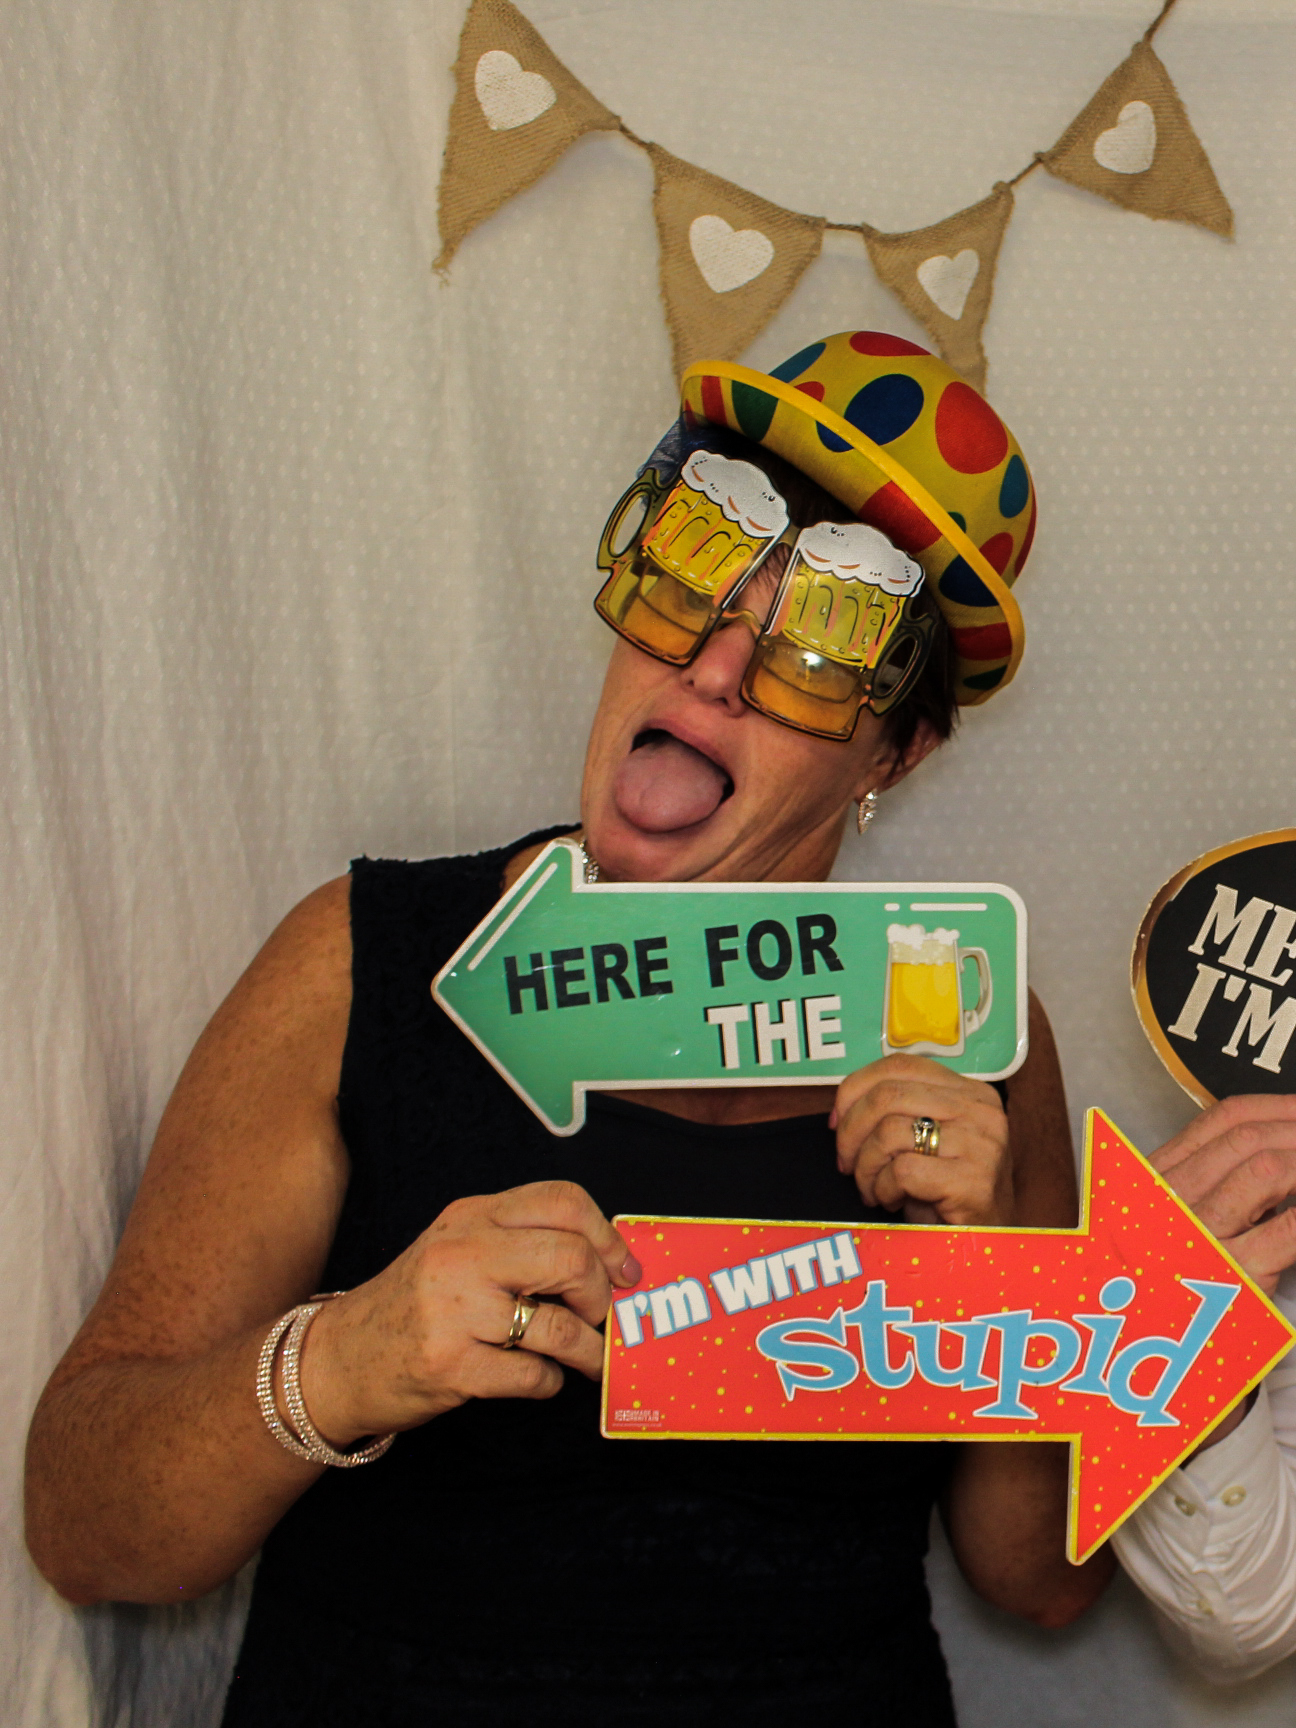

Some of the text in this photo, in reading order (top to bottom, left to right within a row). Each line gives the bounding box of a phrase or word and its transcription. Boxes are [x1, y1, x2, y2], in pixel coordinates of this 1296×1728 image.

[504, 913, 844, 1014] HERE FOR
[704, 994, 846, 1069] THE
[710, 1231, 862, 1315] WITH
[756, 1276, 1240, 1427] stupid
